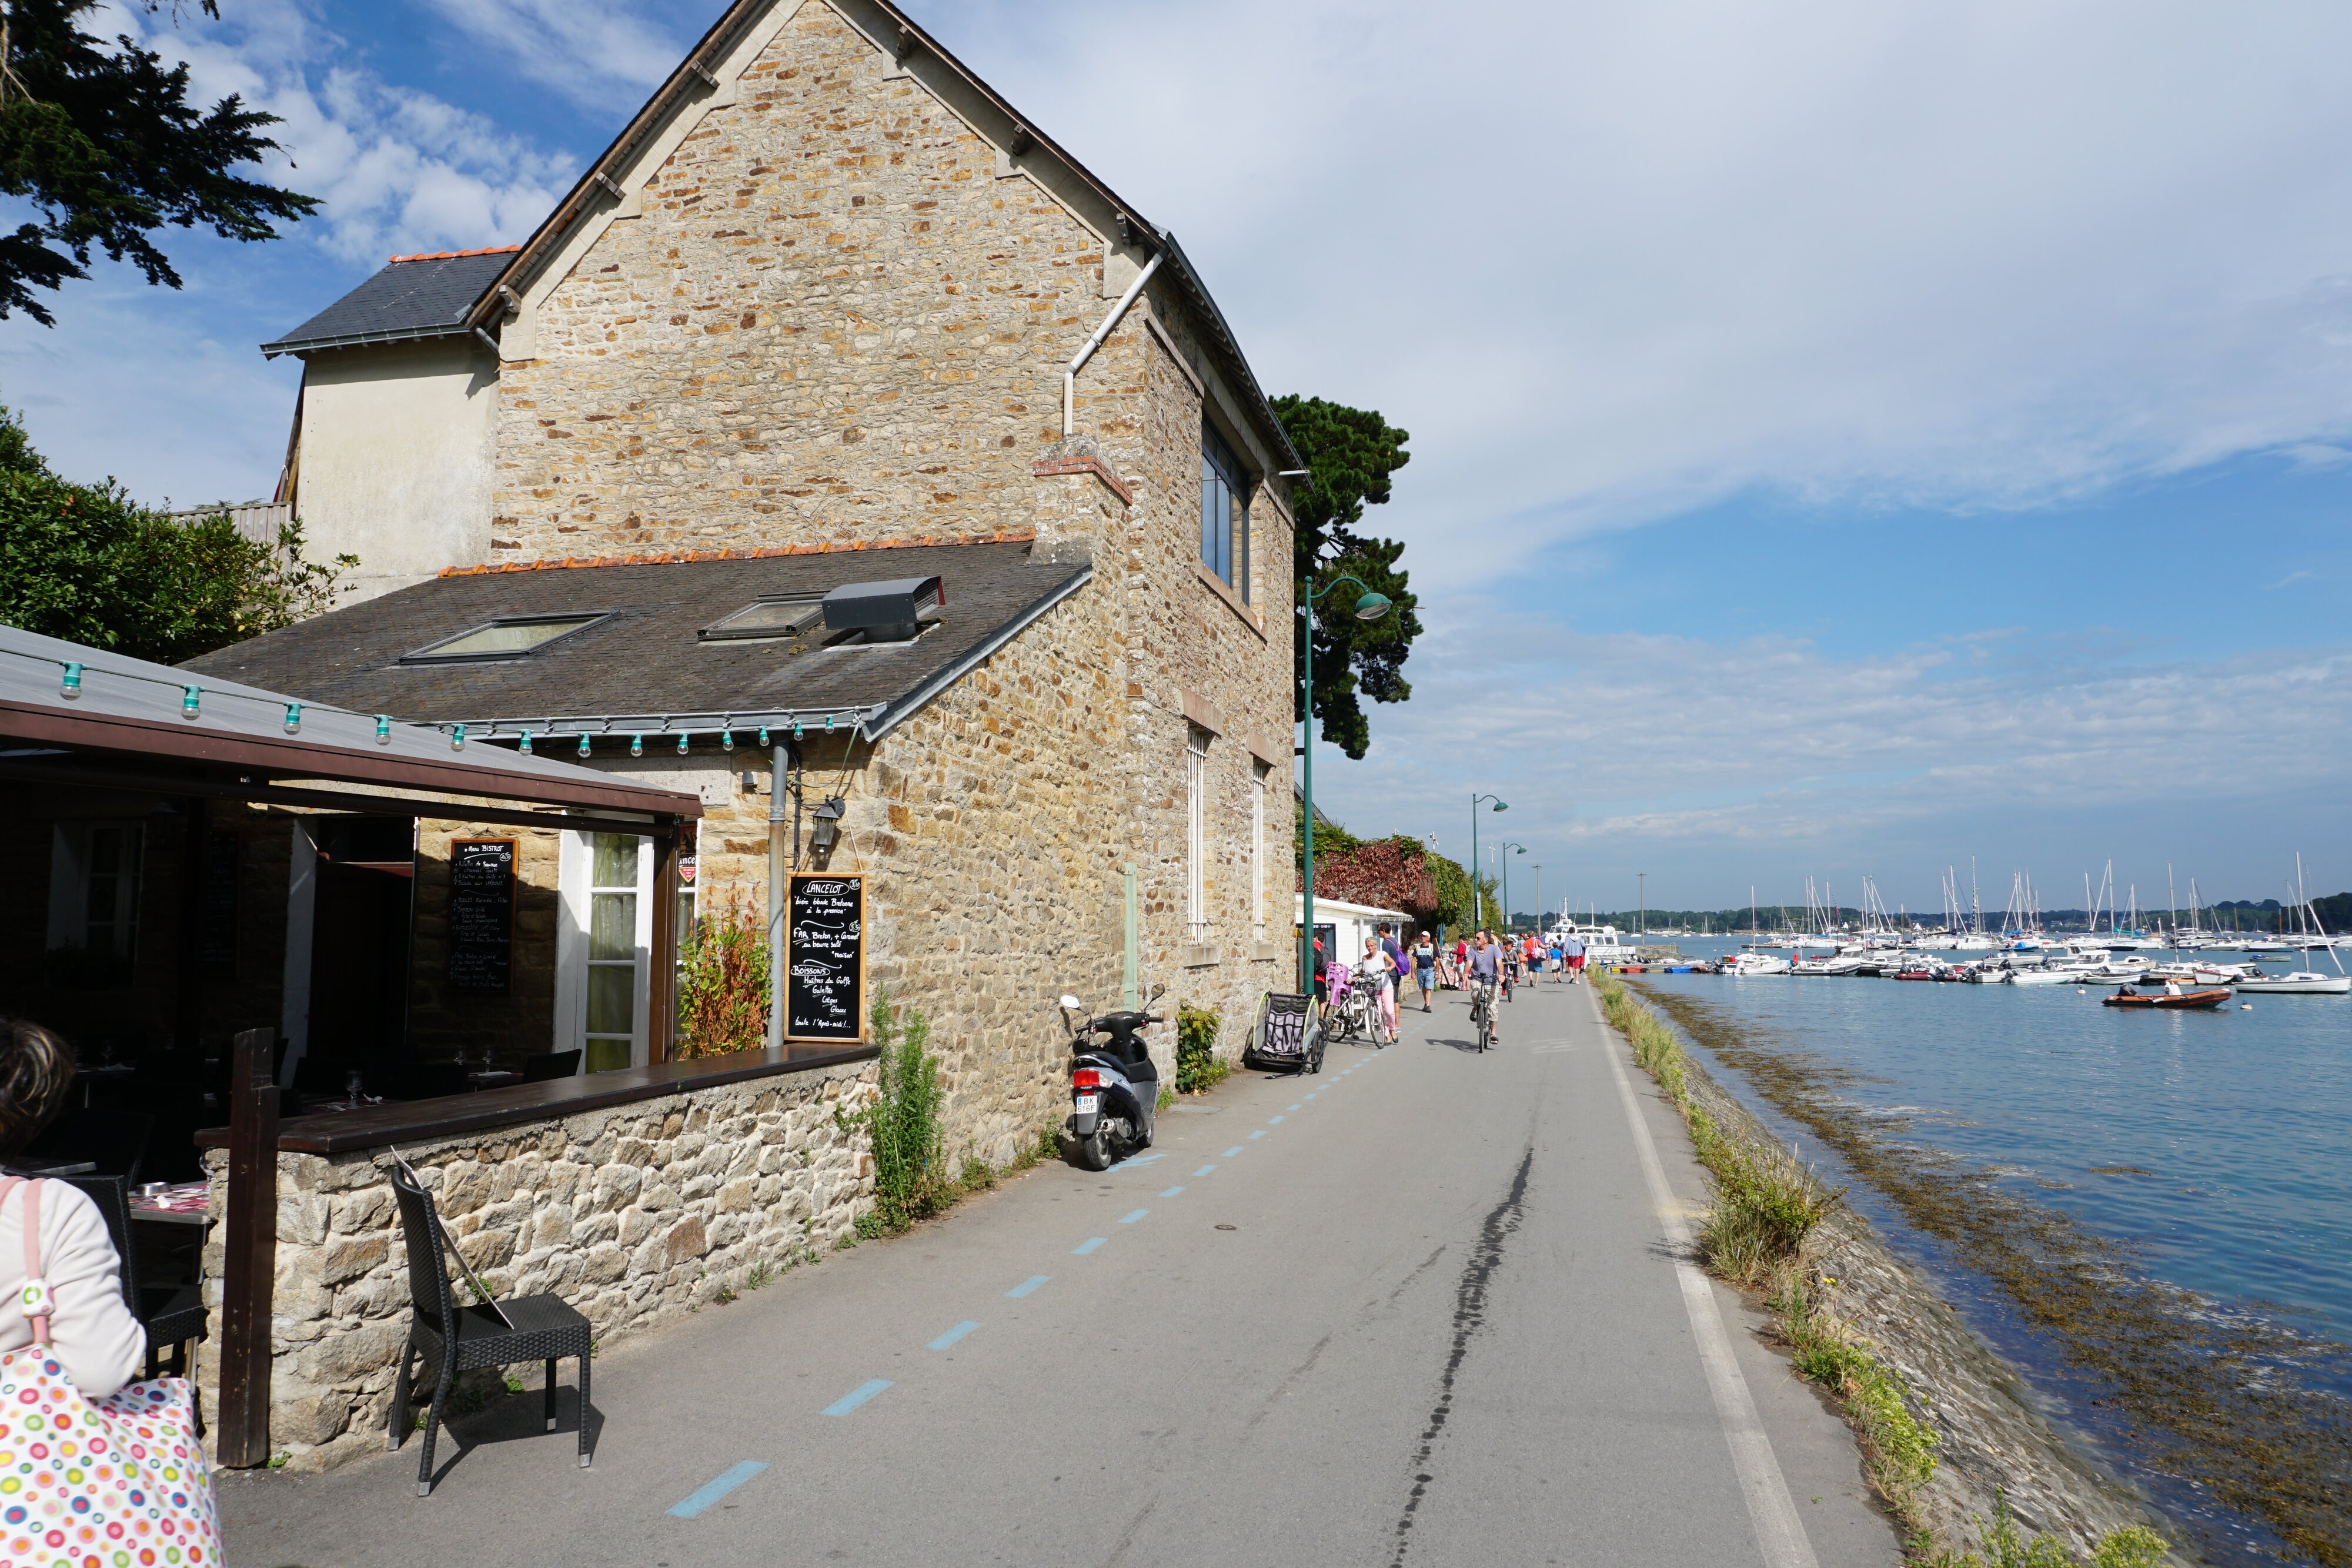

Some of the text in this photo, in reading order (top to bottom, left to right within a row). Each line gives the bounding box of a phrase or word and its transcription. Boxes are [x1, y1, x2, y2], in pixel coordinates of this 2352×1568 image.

[806, 882, 844, 894] LANCELOT
[831, 898, 853, 907] Bretonne
[793, 927, 809, 939] FAR
[841, 931, 860, 940] Caramel
[804, 975, 824, 984] Huîtres
[836, 976, 851, 987] Golfe
[812, 985, 833, 994] Galettes
[822, 995, 838, 1006] Crêpes
[830, 1005, 847, 1013] Glaces
[795, 1015, 809, 1026] toute
